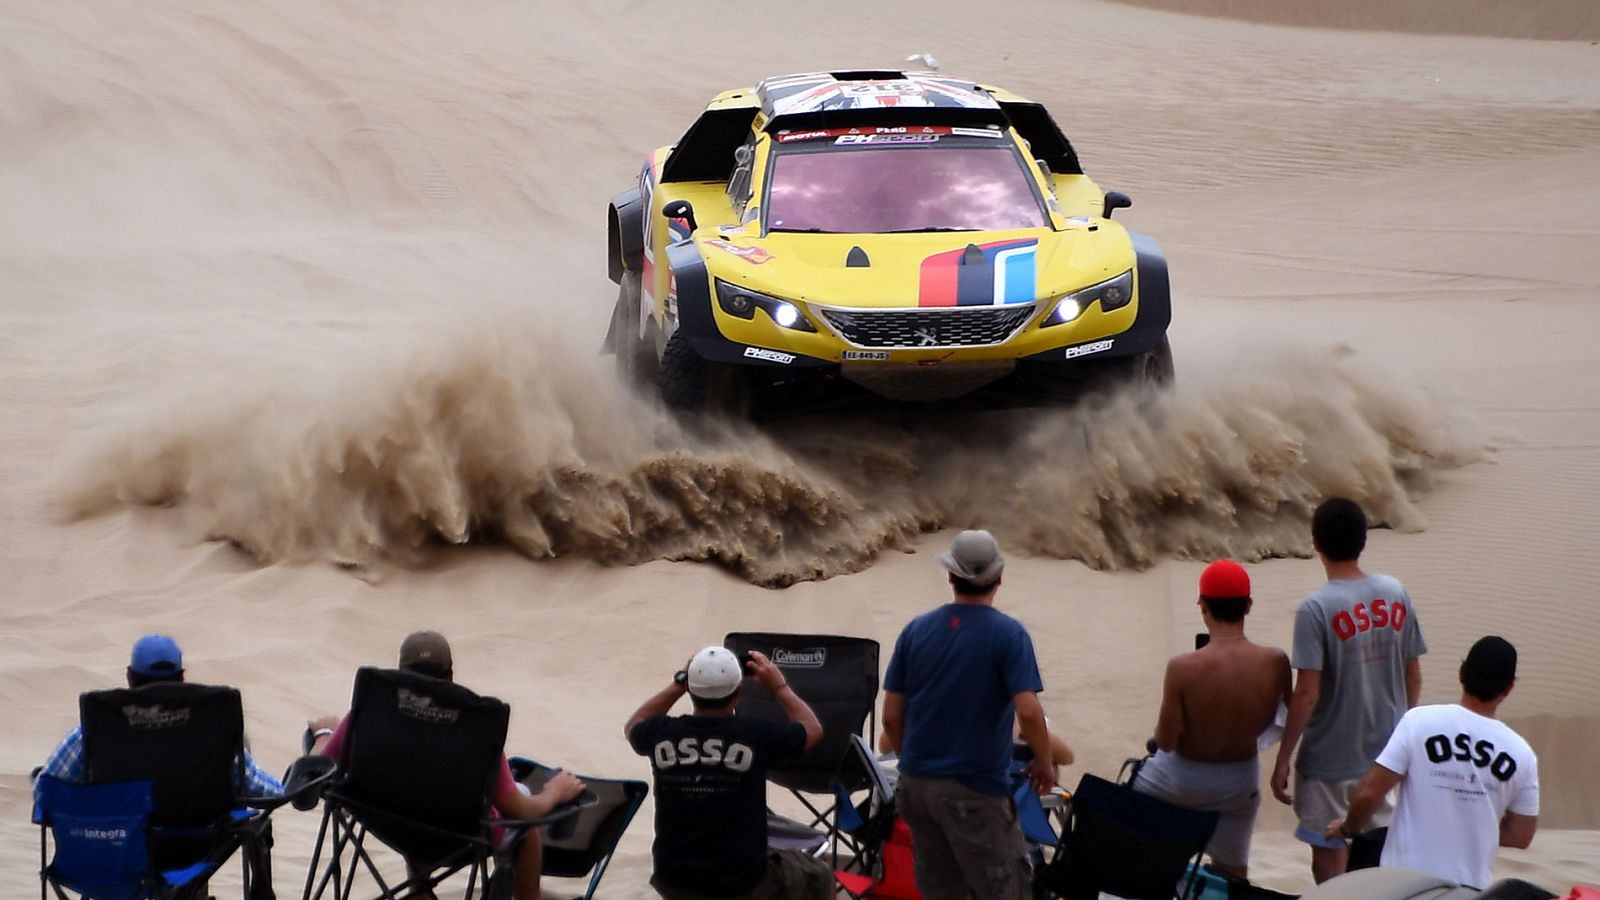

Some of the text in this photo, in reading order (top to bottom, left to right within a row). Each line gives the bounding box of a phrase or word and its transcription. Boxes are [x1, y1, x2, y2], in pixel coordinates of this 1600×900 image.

[783, 131, 827, 141] MOTUL
[1332, 598, 1407, 642] OSSO
[776, 650, 814, 663] Coleman
[654, 738, 753, 772] OSSO
[1424, 733, 1517, 782] OSSO
